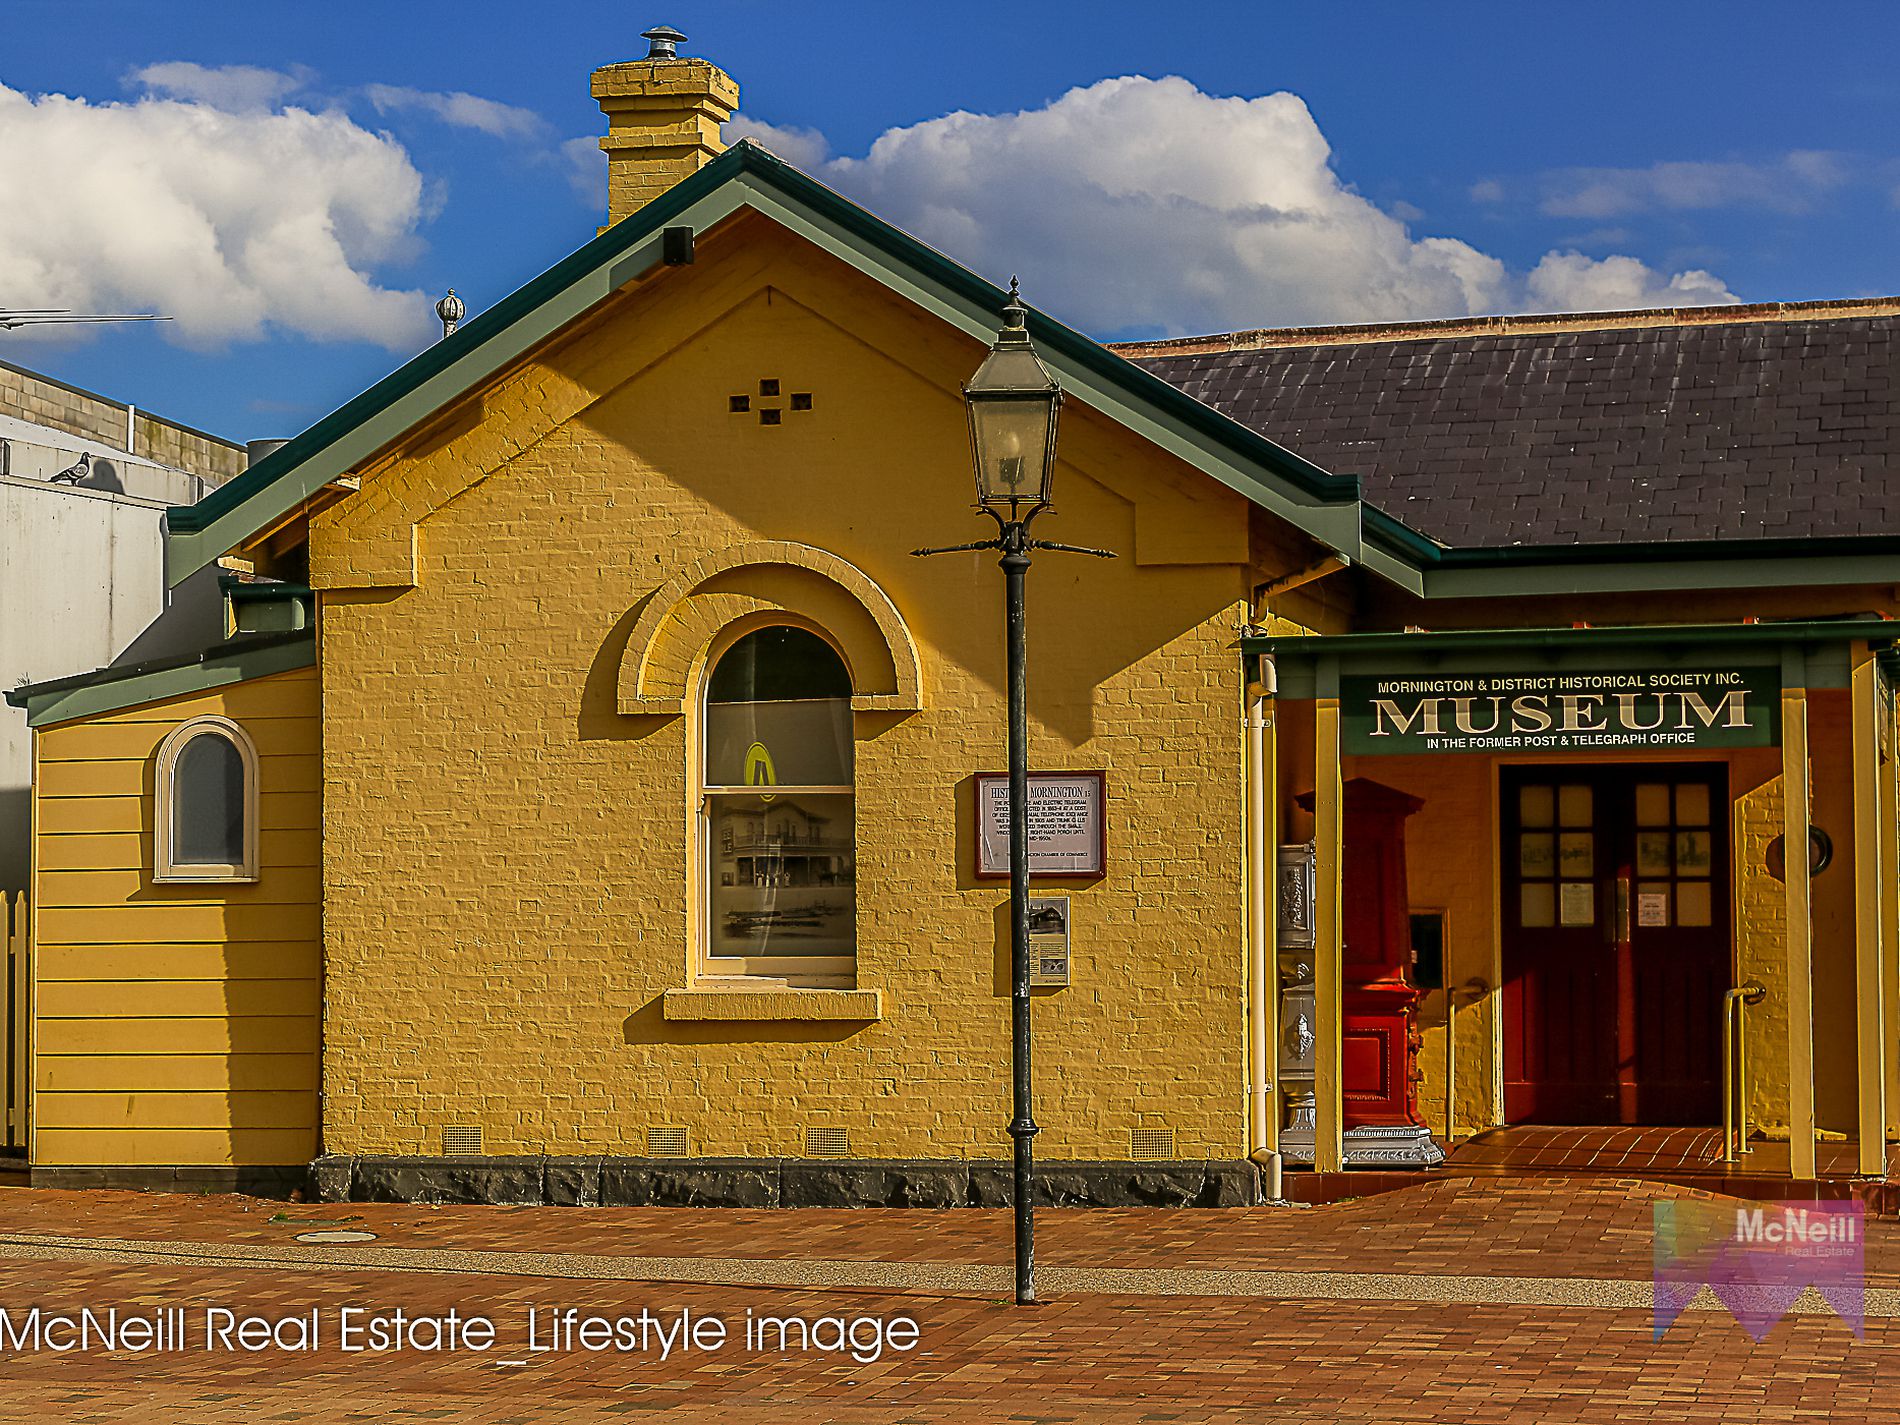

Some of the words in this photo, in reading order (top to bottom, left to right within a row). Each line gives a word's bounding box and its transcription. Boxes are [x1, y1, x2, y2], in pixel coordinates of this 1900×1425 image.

[1378, 680, 1474, 693] MORNINGTON
[1478, 680, 1488, 690] &
[1492, 678, 1556, 690] DISTRICT
[1560, 675, 1646, 689] HISTORICAL
[1649, 673, 1712, 687] SOCIETY
[1715, 672, 1744, 685] INC.
[1368, 690, 1754, 736] MUSEUM
[1426, 738, 1439, 749] IN
[1442, 738, 1466, 748] THE
[1469, 736, 1522, 748] FORMER
[1524, 736, 1558, 746] POST
[1560, 735, 1569, 746] &
[1572, 734, 1646, 746] TELEGRAPH
[1650, 732, 1696, 744] OFFICE
[1030, 786, 1083, 798] MORNINGTON
